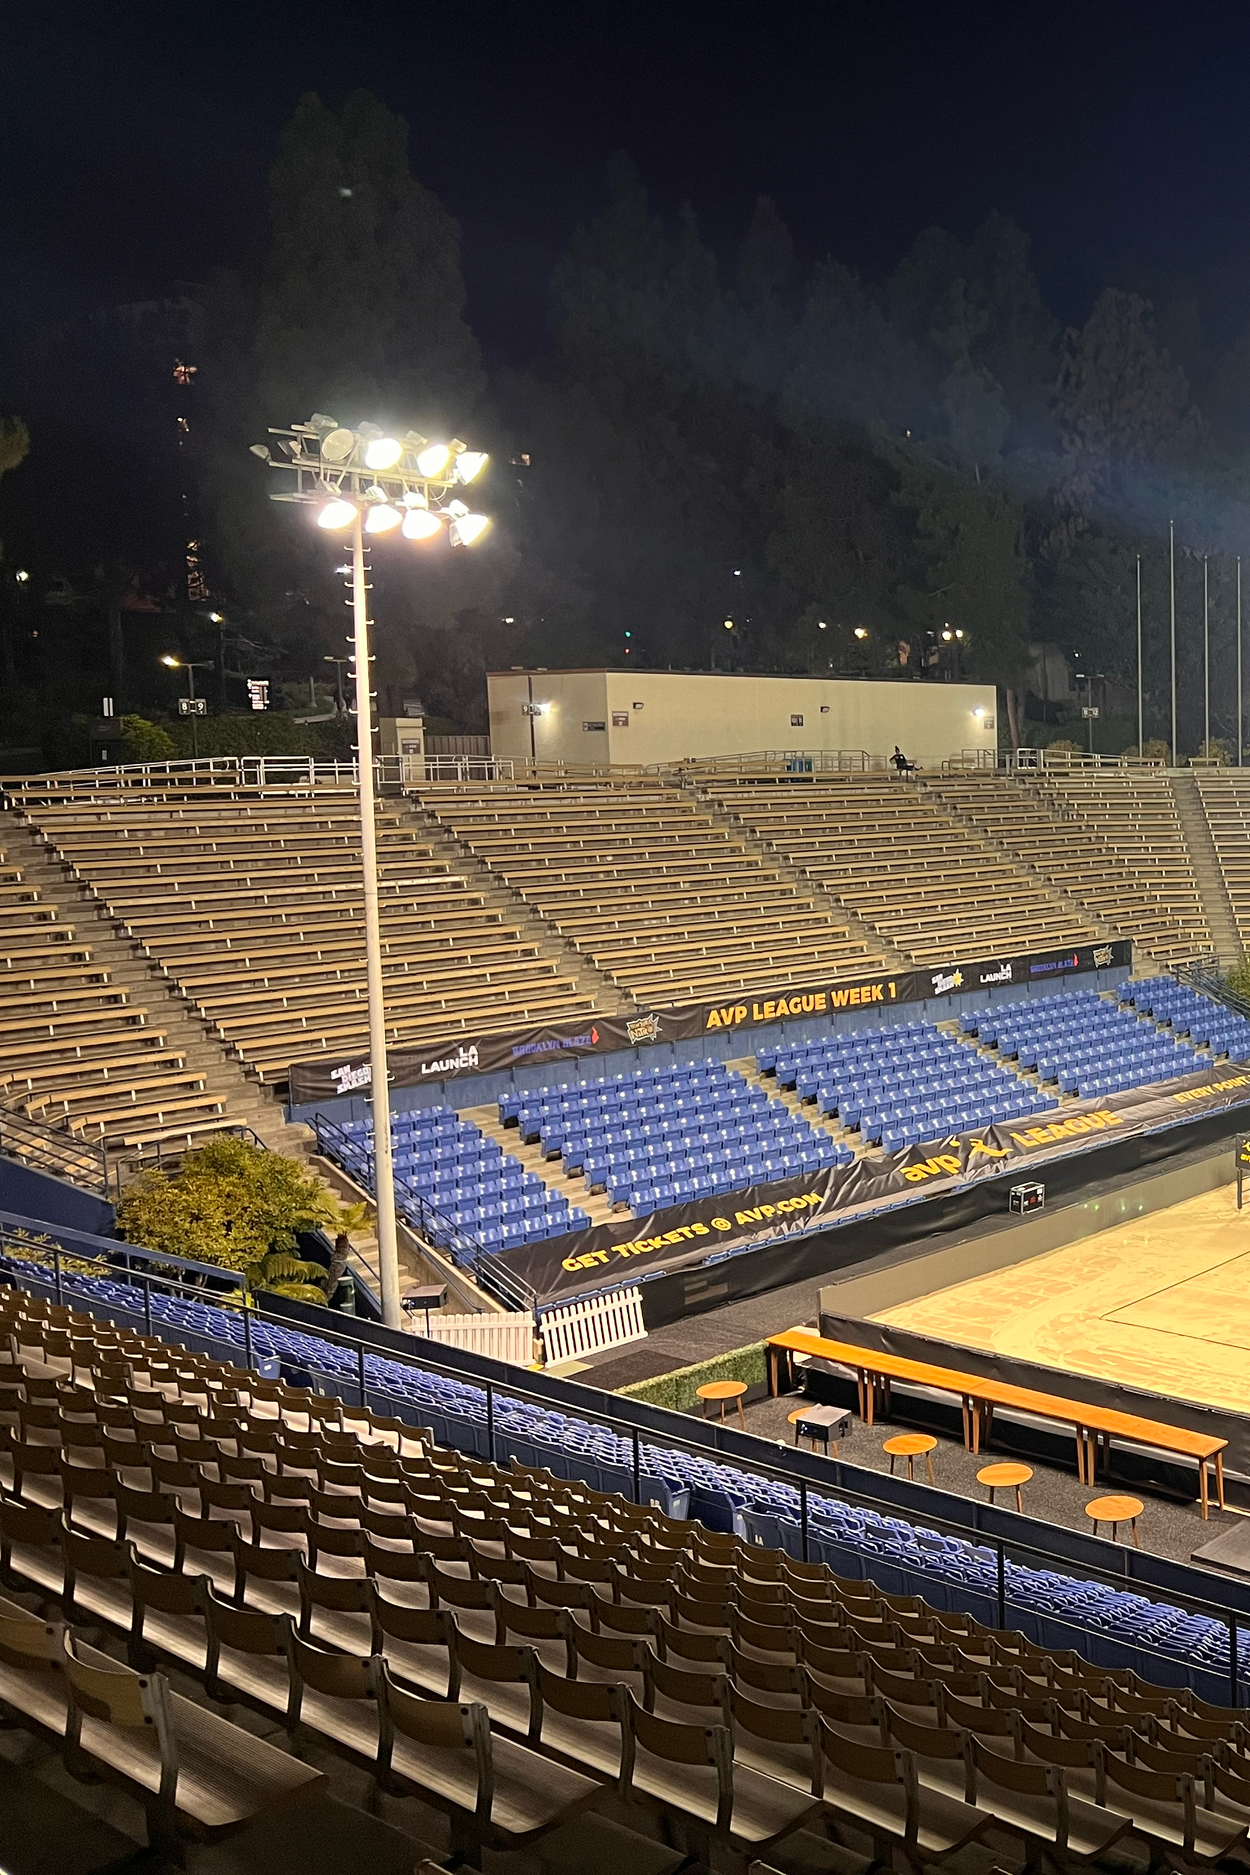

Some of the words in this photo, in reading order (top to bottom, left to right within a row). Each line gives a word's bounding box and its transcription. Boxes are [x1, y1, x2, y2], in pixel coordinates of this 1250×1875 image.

[181, 702, 188, 710] 8
[197, 702, 204, 711] 9
[980, 971, 1012, 983] LAUNCH
[706, 1005, 748, 1029] AVP
[752, 992, 827, 1021] LEAGUE
[830, 984, 884, 1008] WEEK
[888, 982, 897, 998] 1
[458, 1045, 478, 1058] LA
[421, 1055, 479, 1075] LAUNCH
[1172, 1085, 1216, 1104] EVERY
[1213, 1075, 1250, 1092] POINT
[900, 1154, 963, 1182] avp
[1009, 1109, 1124, 1148] LEAGUE
[561, 1249, 611, 1272] GET
[610, 1222, 710, 1259] TICKETS
[710, 1217, 732, 1232] @
[734, 1190, 825, 1226] AVP.COM
